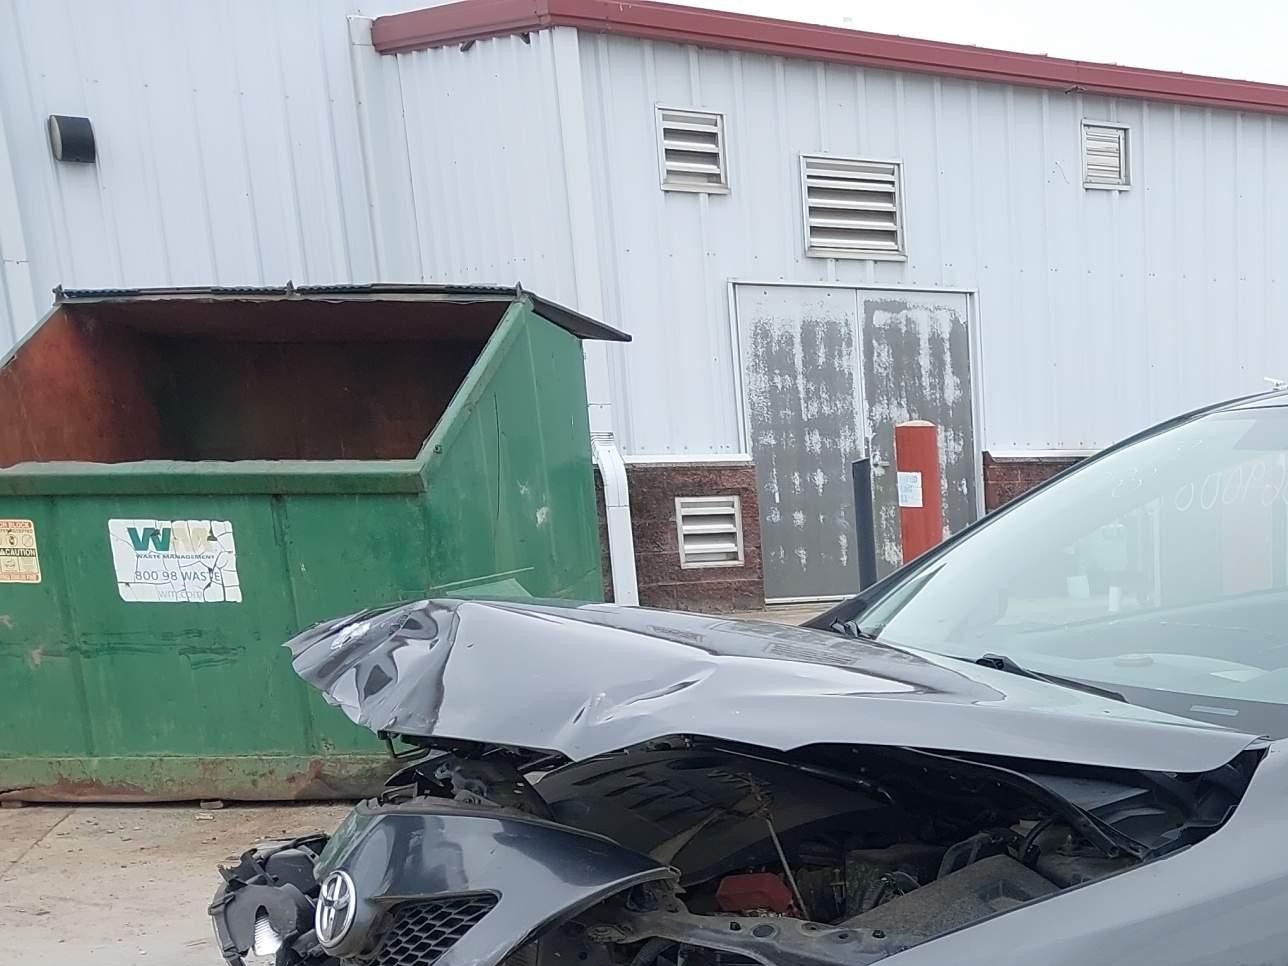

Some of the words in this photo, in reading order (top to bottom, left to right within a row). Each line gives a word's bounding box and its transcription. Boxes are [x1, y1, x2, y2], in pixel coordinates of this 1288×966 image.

[5, 549, 36, 557] CAUTION
[135, 571, 159, 581] 800
[162, 571, 178, 581] 98
